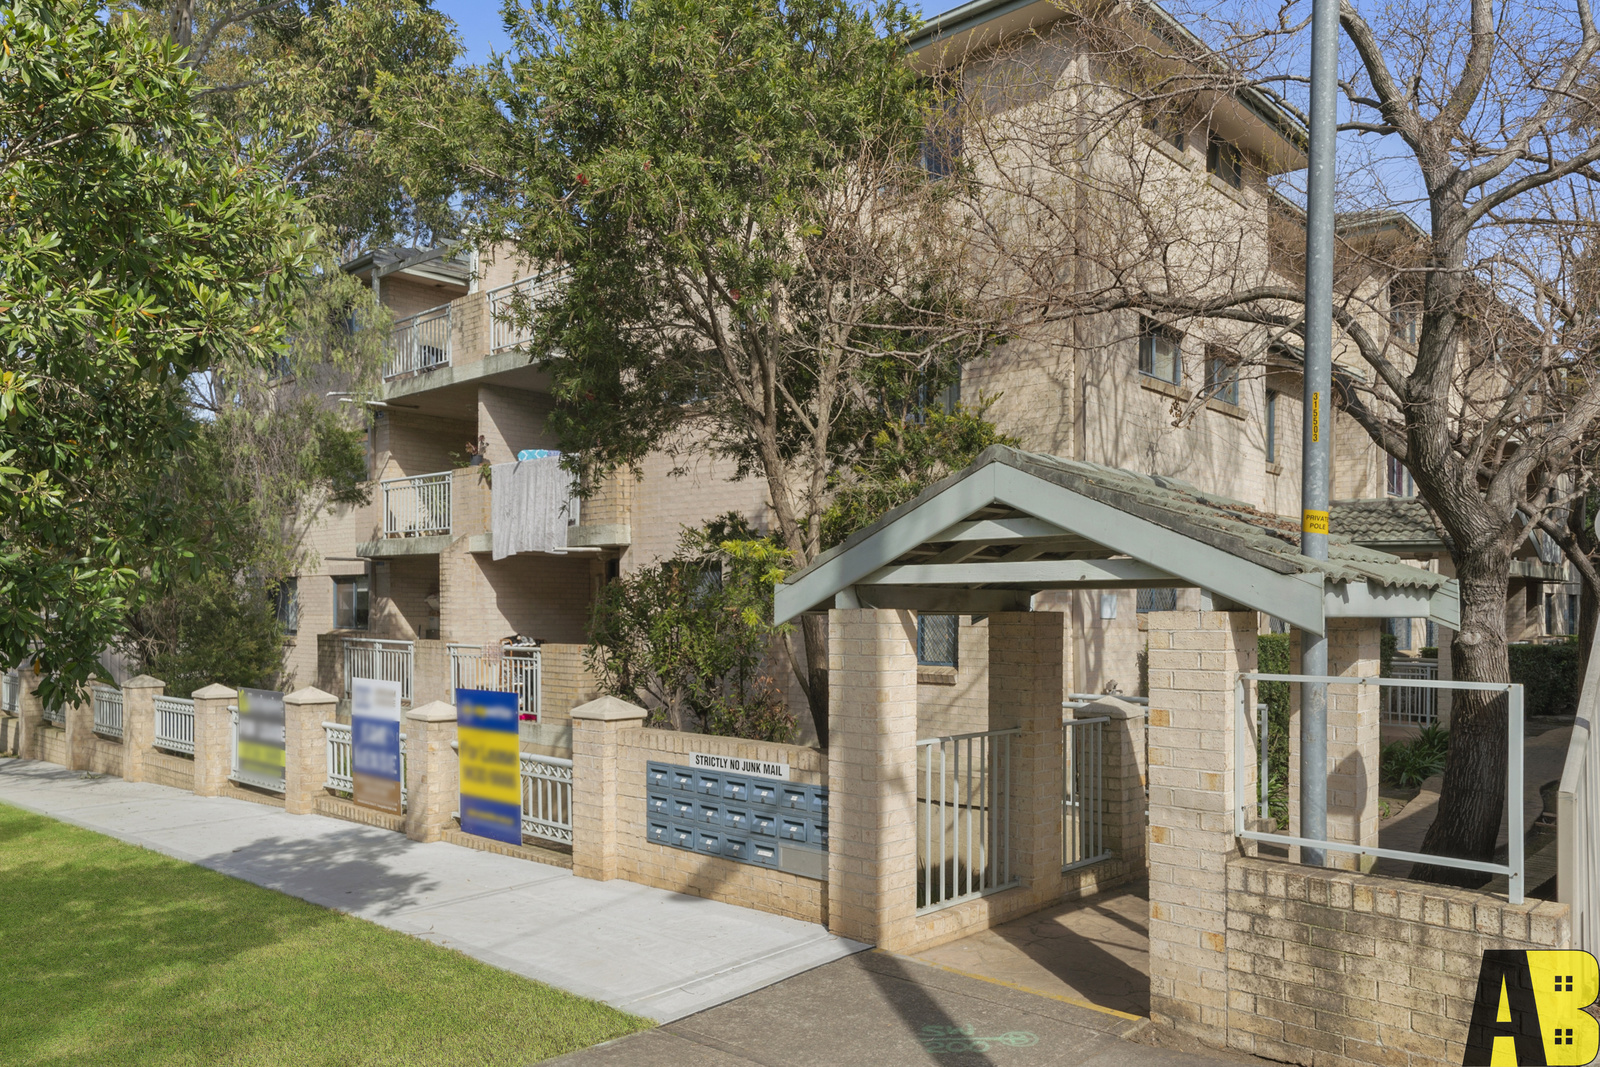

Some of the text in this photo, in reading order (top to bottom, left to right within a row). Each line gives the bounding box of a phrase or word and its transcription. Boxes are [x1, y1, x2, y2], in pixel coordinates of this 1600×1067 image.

[1309, 522, 1326, 530] POLE
[695, 754, 783, 777] STRICTLY NO JUNK MAIL
